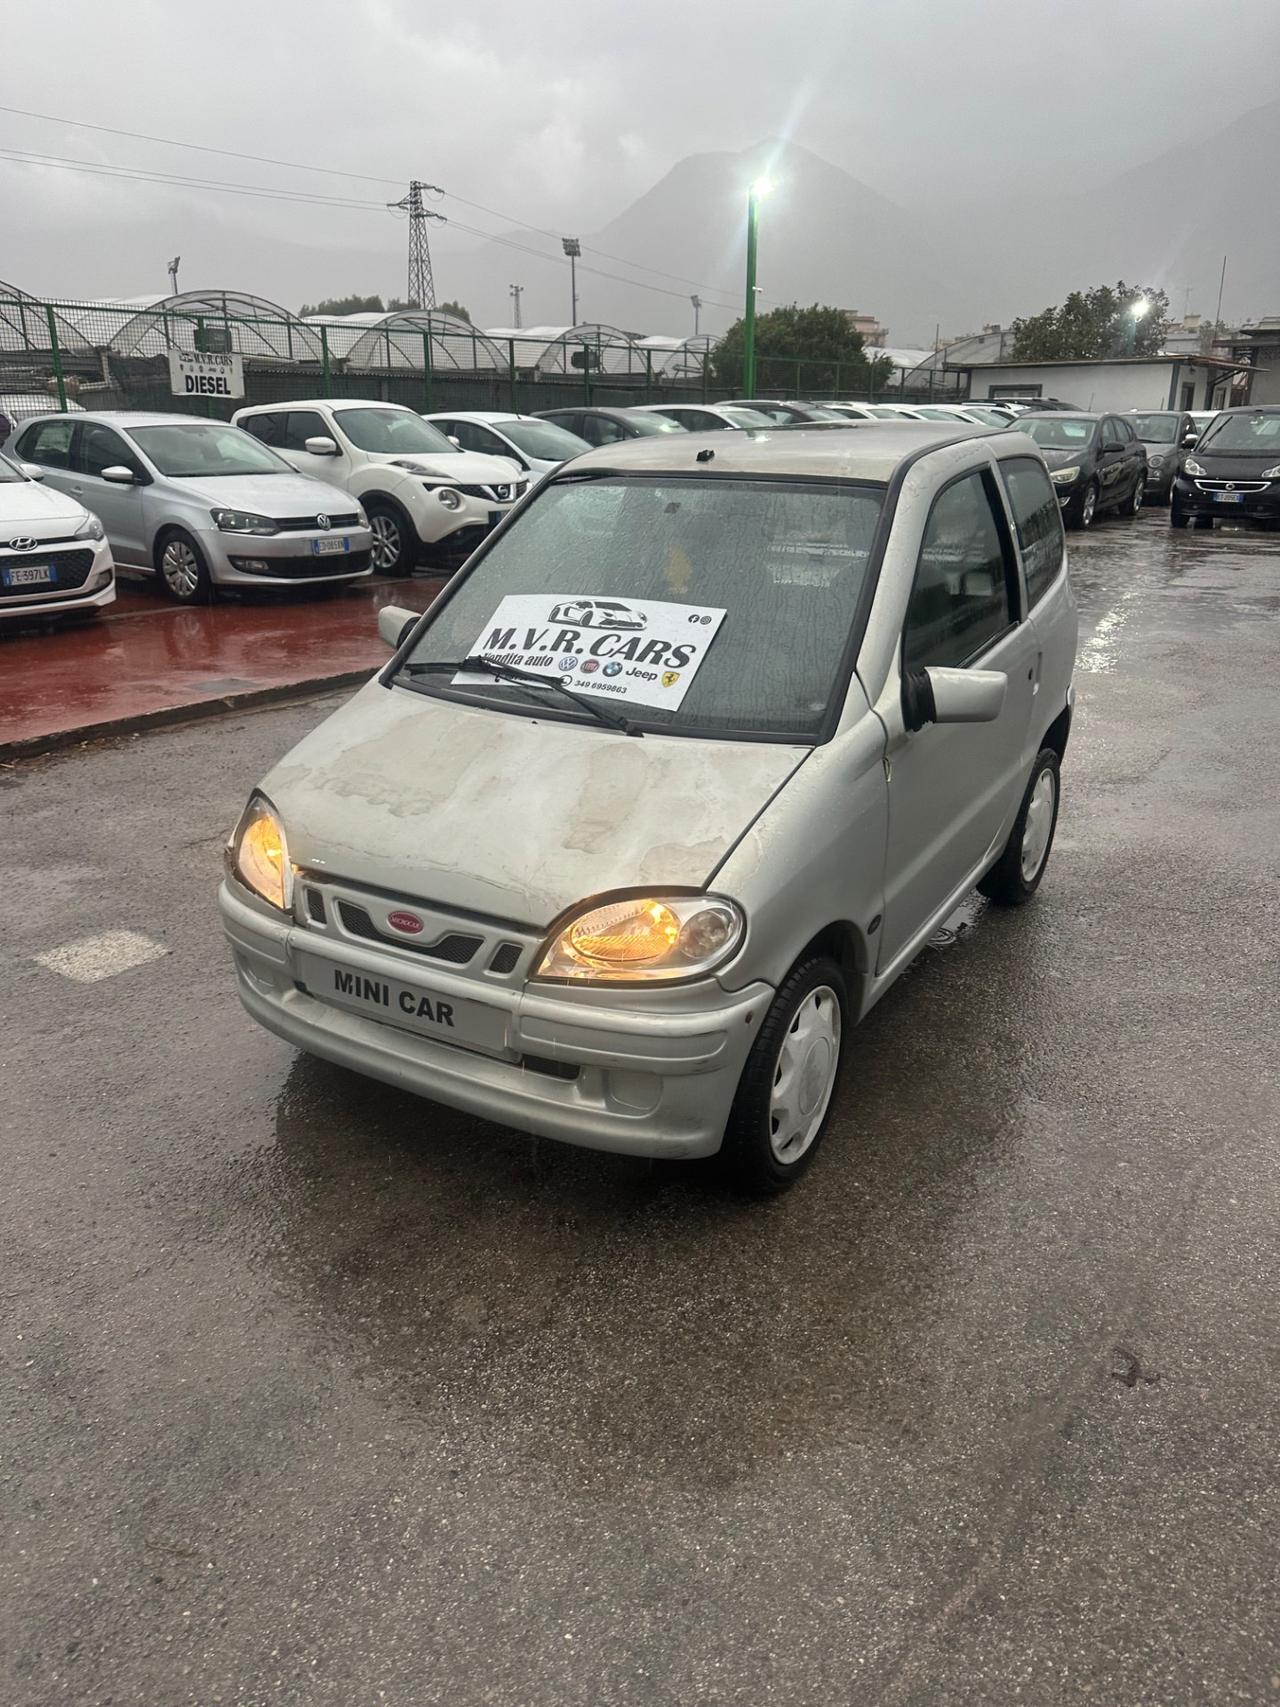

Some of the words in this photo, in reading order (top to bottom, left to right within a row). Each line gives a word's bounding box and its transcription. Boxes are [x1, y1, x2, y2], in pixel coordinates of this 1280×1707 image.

[185, 375, 231, 395] DIESEL
[524, 654, 553, 667] auto
[625, 667, 658, 681] Jeep
[334, 969, 389, 1007] MINI
[398, 991, 455, 1027] CAR
